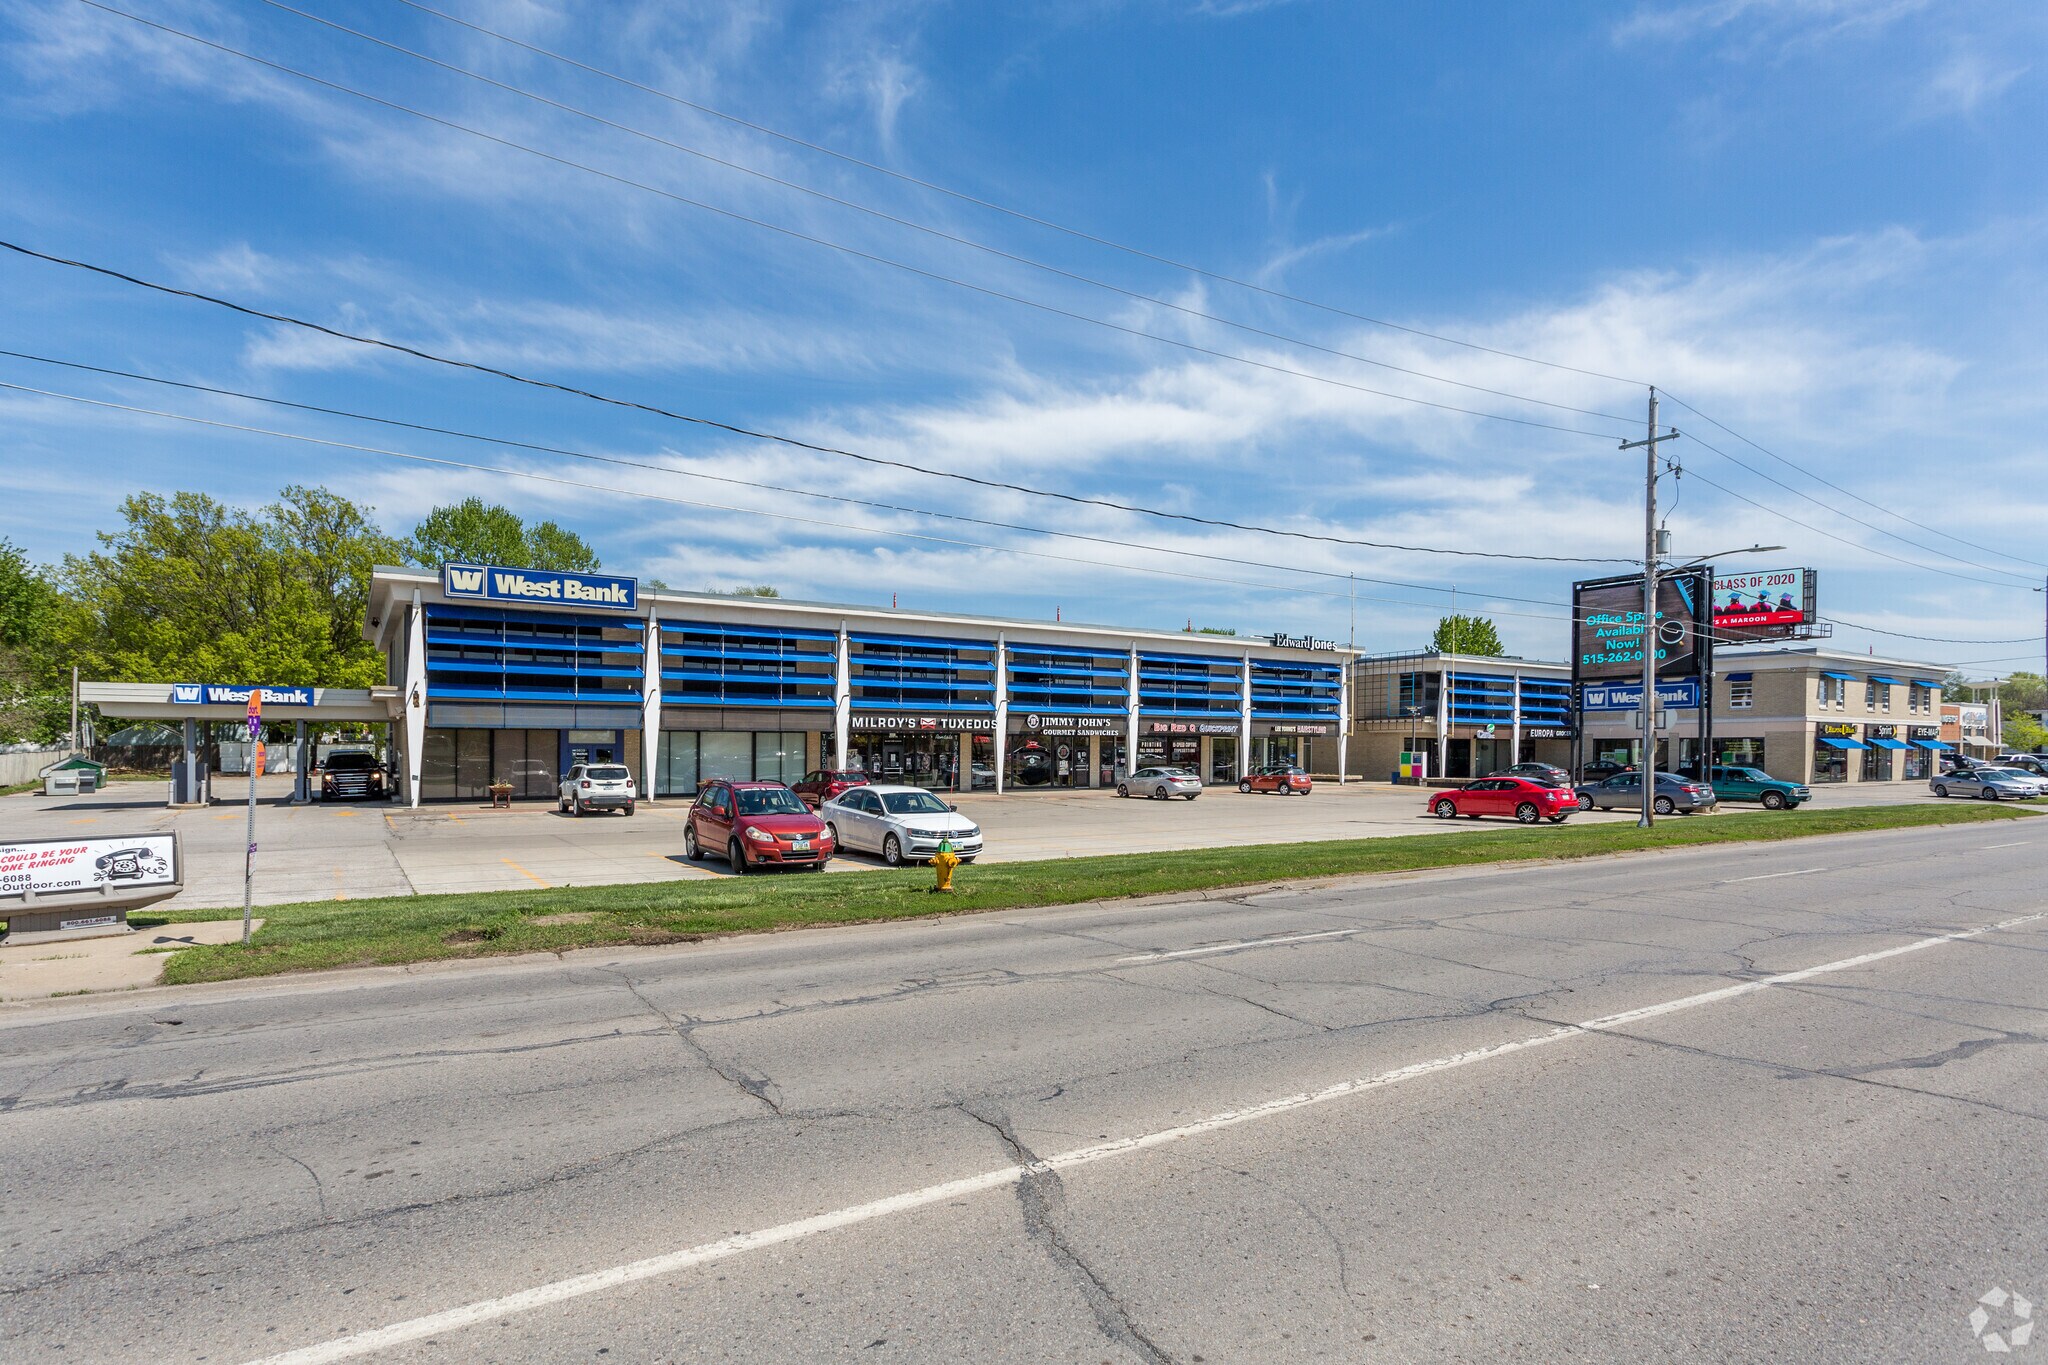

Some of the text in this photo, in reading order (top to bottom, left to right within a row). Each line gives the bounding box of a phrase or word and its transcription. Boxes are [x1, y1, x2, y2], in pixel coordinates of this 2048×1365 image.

[494, 573, 561, 598] West
[563, 579, 628, 603] Bank
[1713, 573, 1795, 590] CLASS OF 2020
[1586, 613, 1622, 626] Office
[1730, 616, 1767, 624] MAROON
[1595, 623, 1644, 638] Availabl
[1606, 638, 1640, 650] Now!
[1583, 649, 1666, 665] 515-262-000
[208, 687, 252, 702] Wes
[260, 688, 308, 703] Bank
[852, 717, 998, 729] MILROY'S TUXEDOS
[1041, 717, 1076, 727] JIMMY
[1078, 718, 1111, 728] JOHN'S
[1530, 729, 1554, 737] EUROPA
[1878, 725, 1893, 737] Sprint
[1, 846, 88, 863] COULD BE YOUR
[28, 856, 75, 869] RINGING
